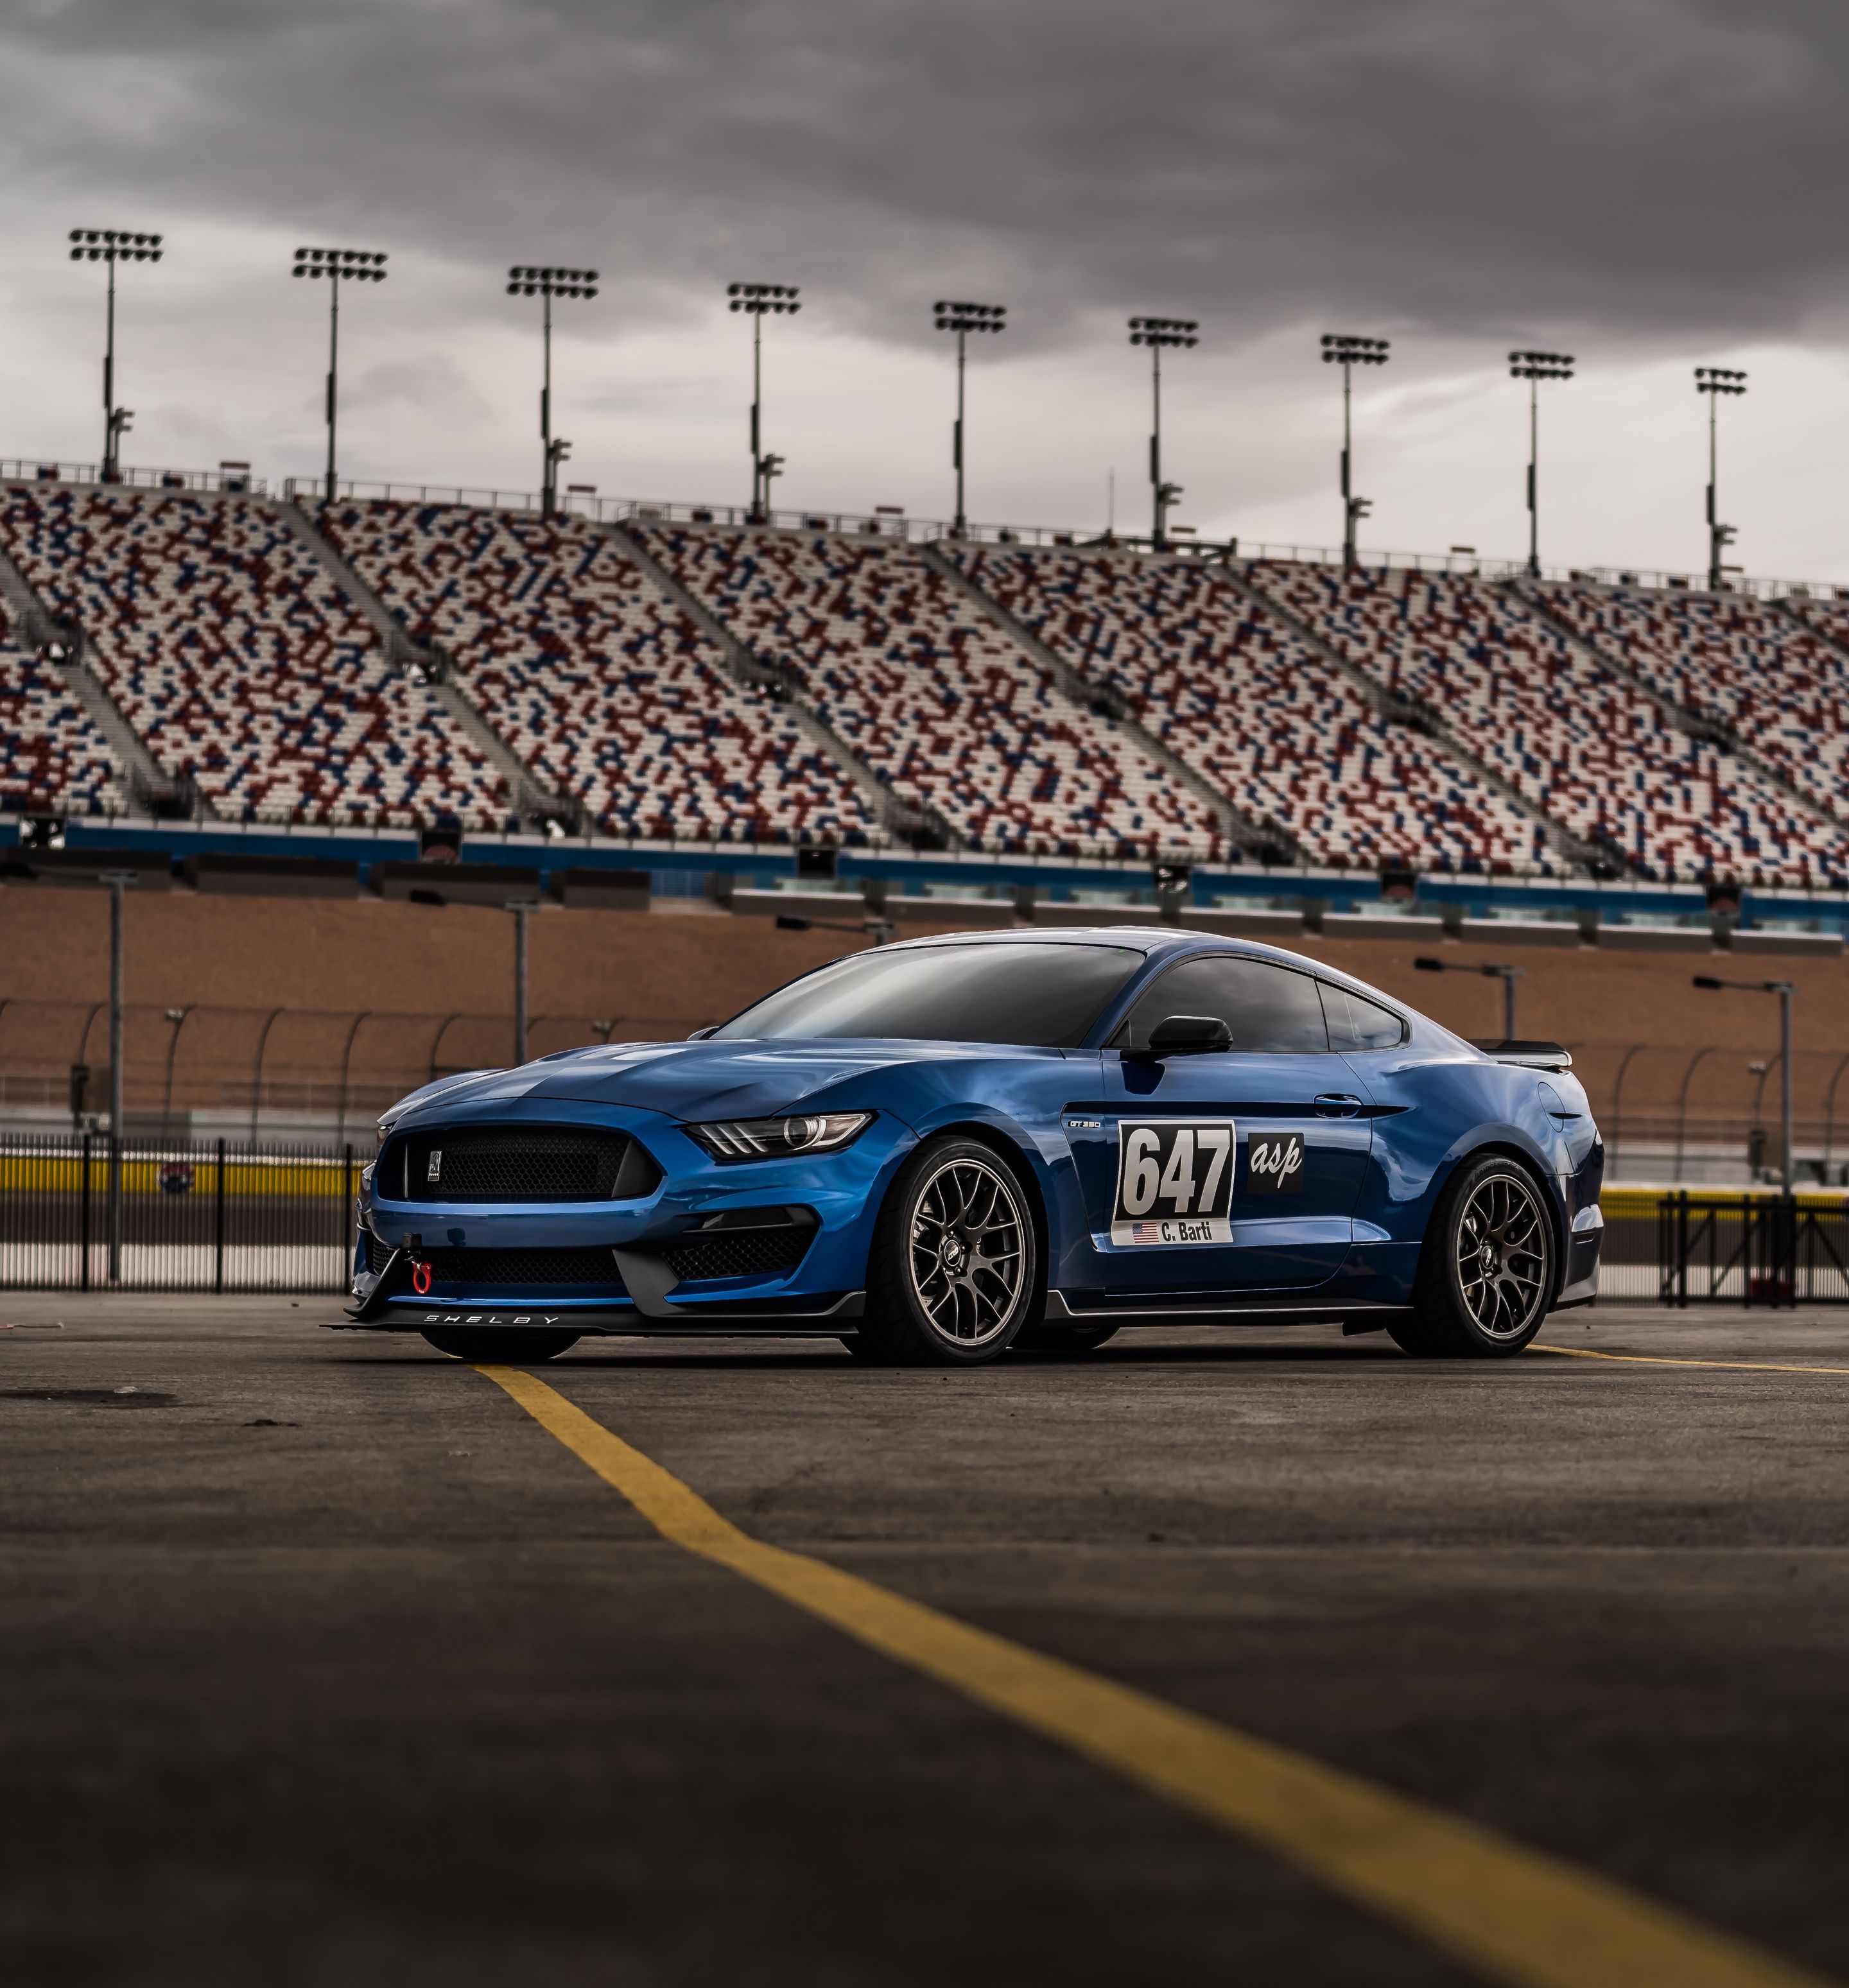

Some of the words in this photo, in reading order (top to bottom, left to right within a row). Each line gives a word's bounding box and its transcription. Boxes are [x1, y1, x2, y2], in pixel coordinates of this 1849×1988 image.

[1123, 1128, 1229, 1216] 647
[1251, 1137, 1302, 1189] asp
[1161, 1222, 1176, 1241] C.
[1179, 1222, 1213, 1241] Barti
[424, 1315, 559, 1324] SHELBY
